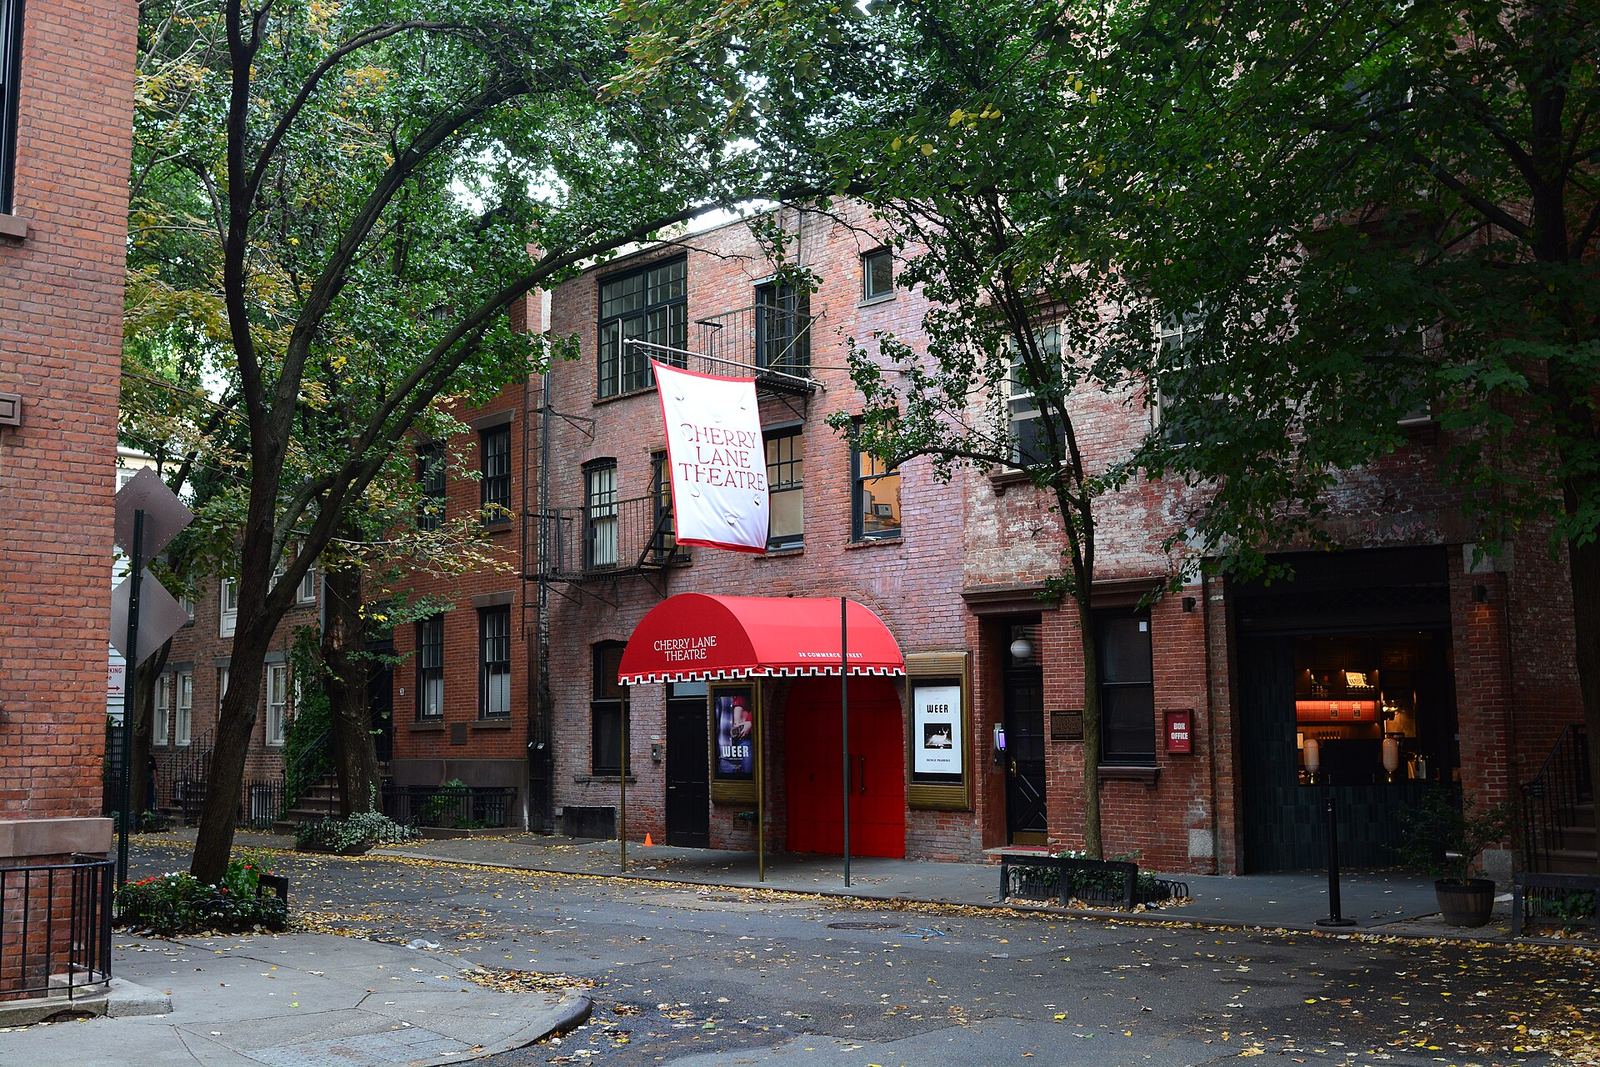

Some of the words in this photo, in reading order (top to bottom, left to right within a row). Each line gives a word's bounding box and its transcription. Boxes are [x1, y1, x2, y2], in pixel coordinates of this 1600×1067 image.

[680, 423, 757, 449] CHERRY
[696, 446, 751, 469] LANE
[678, 462, 766, 492] THEATRE
[653, 638, 690, 651] CHERRY
[691, 635, 718, 649] LANE
[664, 648, 708, 661] THEATRE
[926, 704, 949, 714] WEER
[1173, 722, 1186, 730] BOX
[1170, 732, 1189, 740] OFFICE
[722, 745, 749, 758] WEER
